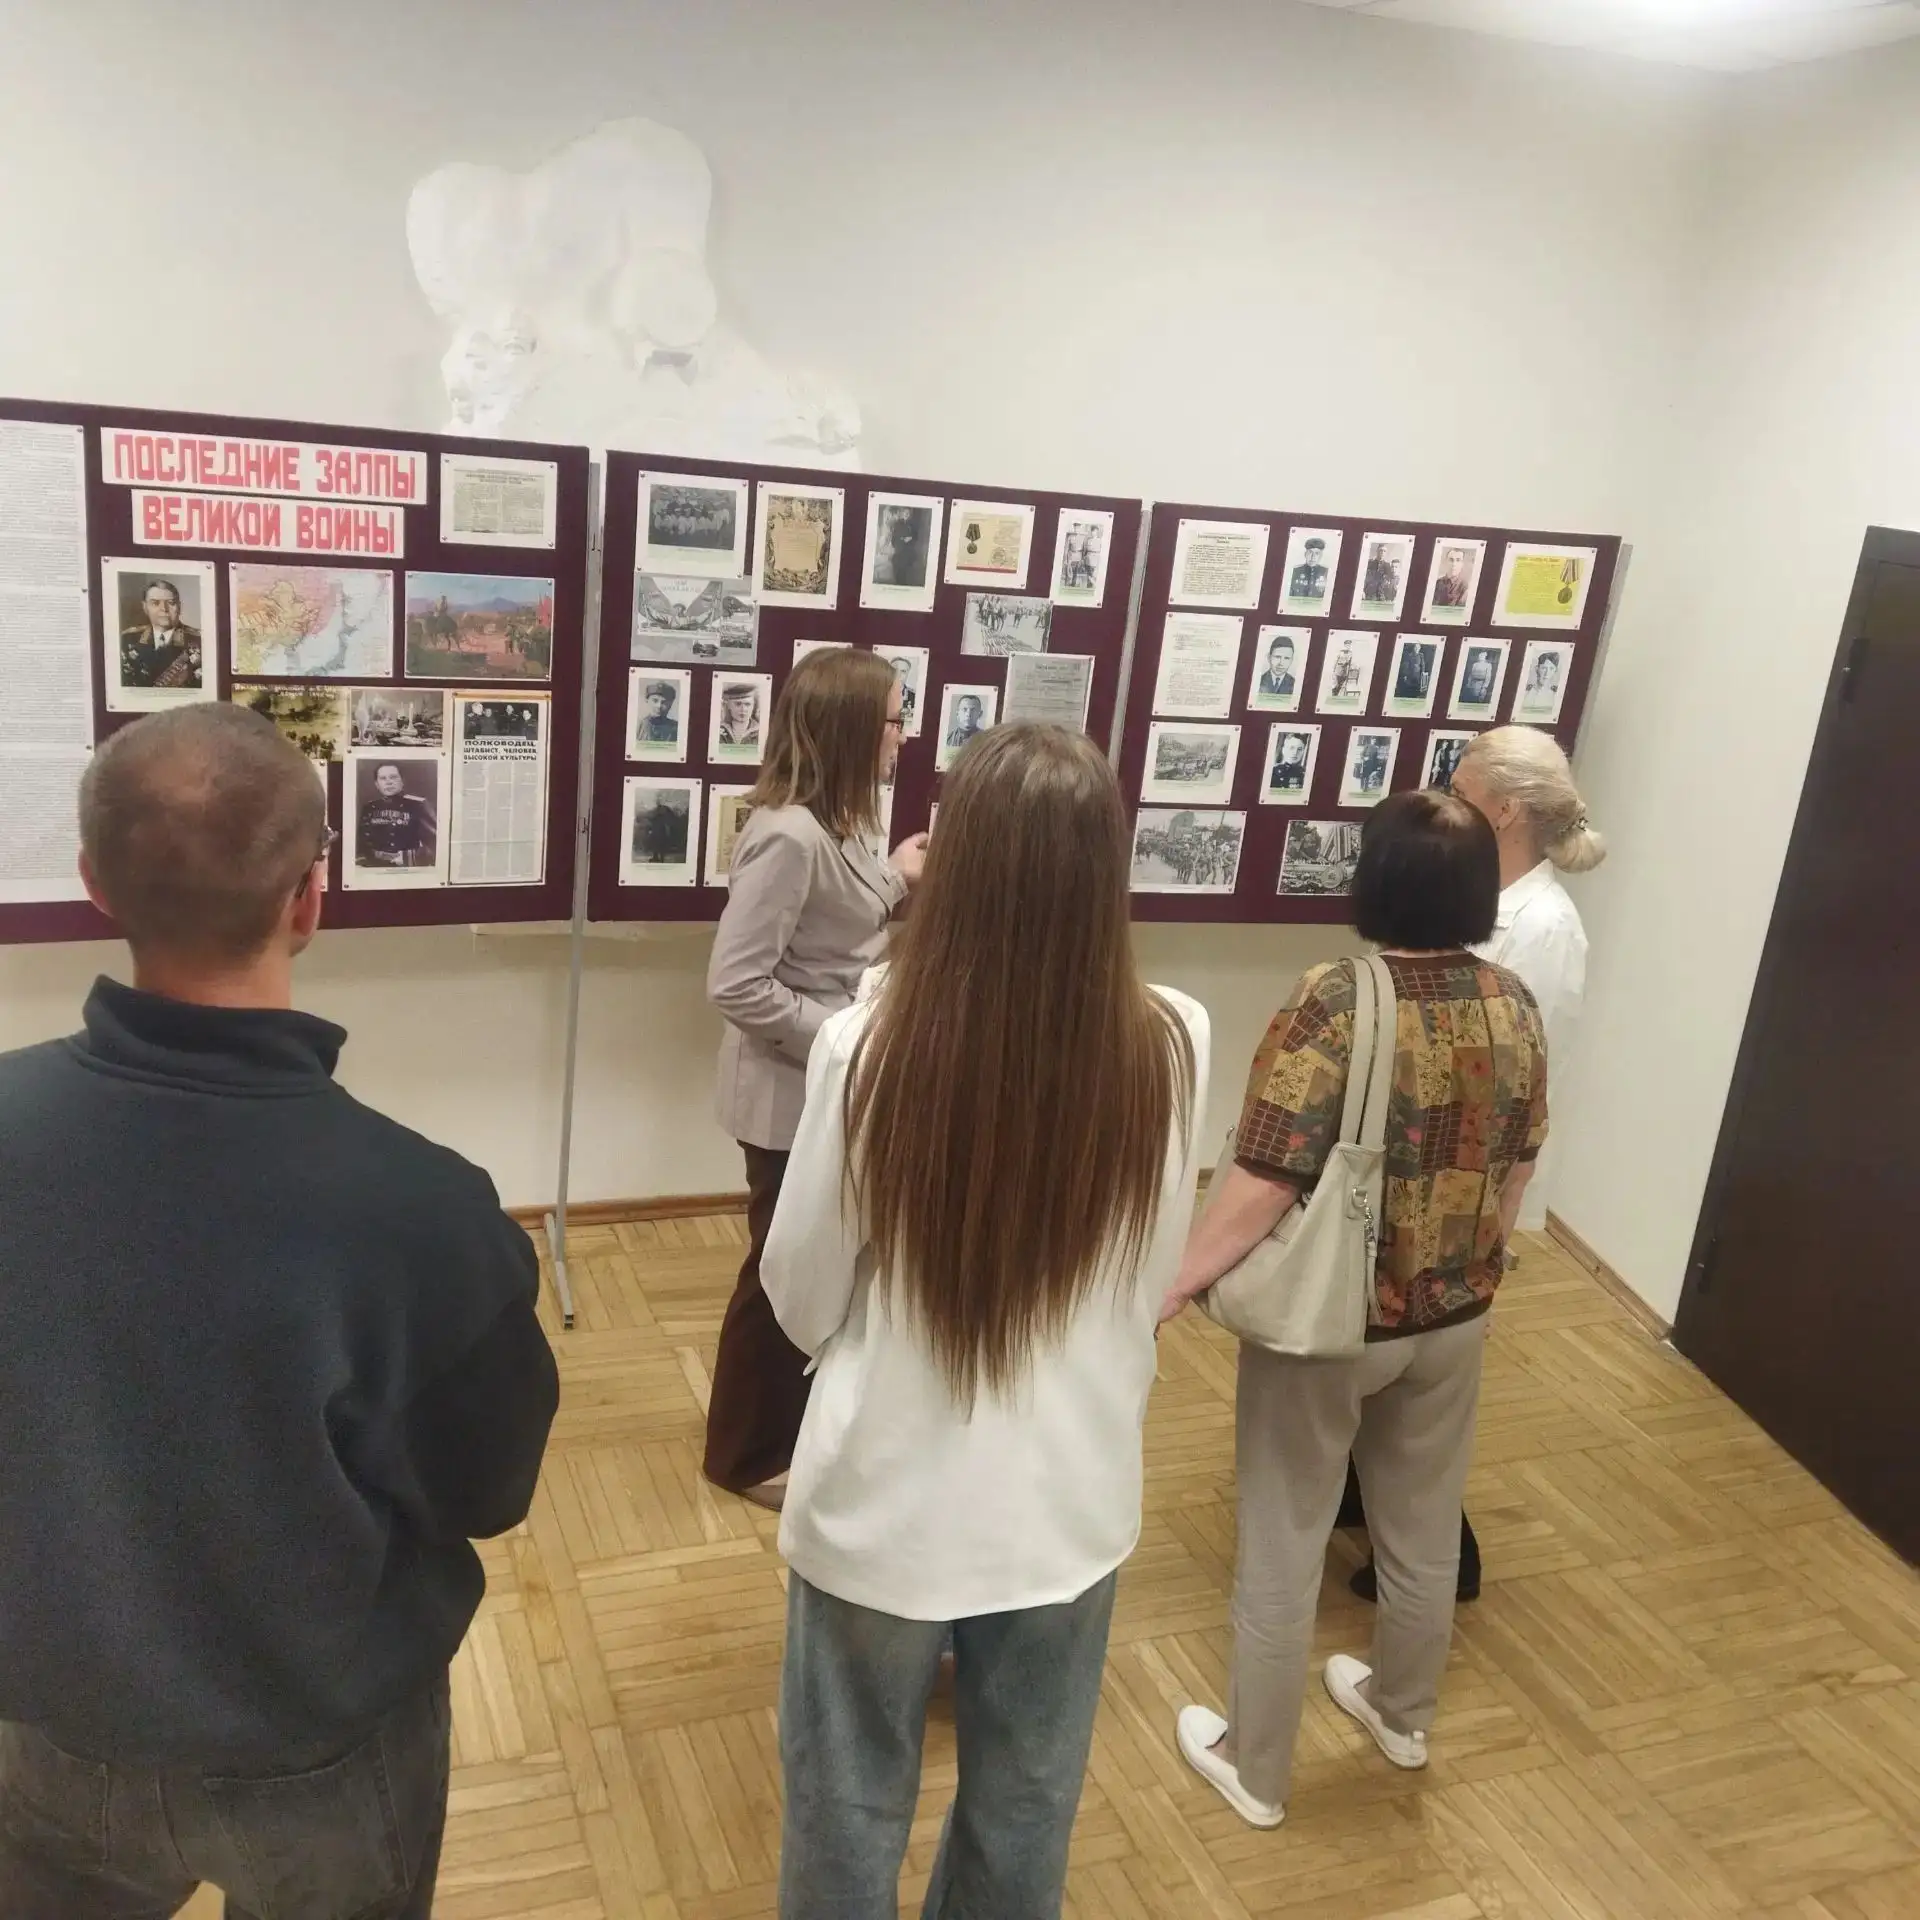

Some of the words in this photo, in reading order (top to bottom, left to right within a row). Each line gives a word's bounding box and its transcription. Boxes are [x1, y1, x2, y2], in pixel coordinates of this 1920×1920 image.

[114, 434, 300, 491] ПОСЛЕДНИЕ
[316, 450, 415, 499] ЗАЛПЫ
[143, 495, 281, 547] ВЕЛИКОЙ
[296, 505, 395, 553] ВОЙНЫ
